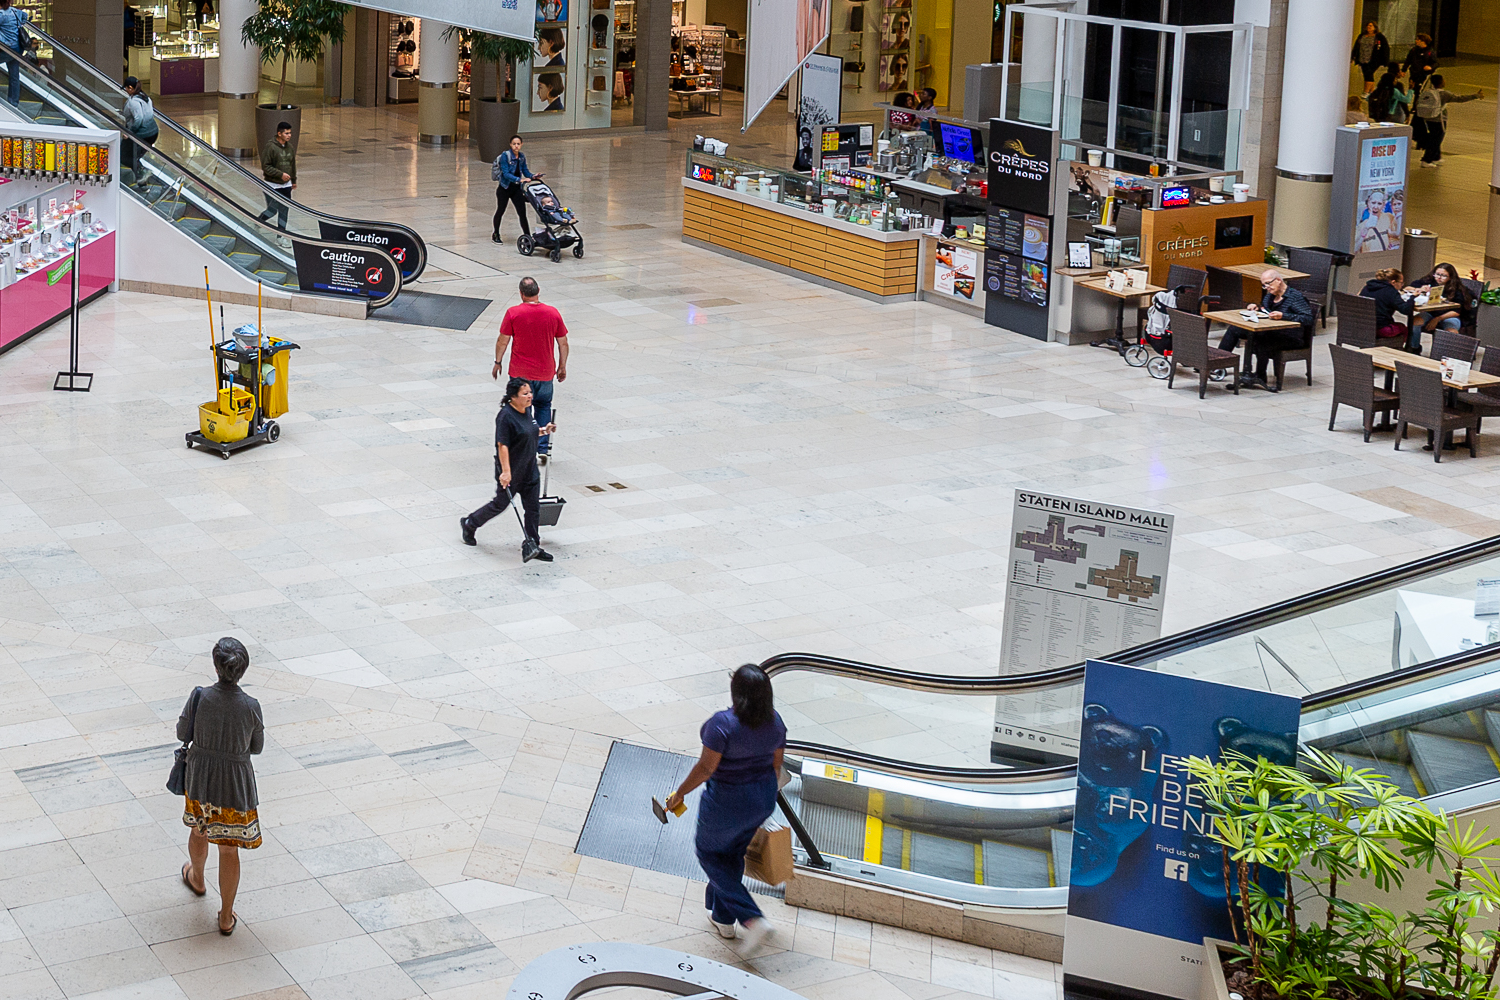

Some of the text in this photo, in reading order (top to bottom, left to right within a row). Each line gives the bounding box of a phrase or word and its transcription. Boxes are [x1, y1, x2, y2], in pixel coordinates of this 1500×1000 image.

[1372, 145, 1397, 158] RISE UP
[990, 151, 1050, 174] CRÊPES
[998, 166, 1043, 181] DU NORD
[346, 231, 389, 245] Caution
[320, 249, 365, 264] Caution
[1164, 250, 1203, 261] DU NORD
[1019, 493, 1169, 529] STATEN ISLAND MALL
[1162, 780, 1203, 809] BE
[1156, 844, 1200, 860] Find us on
